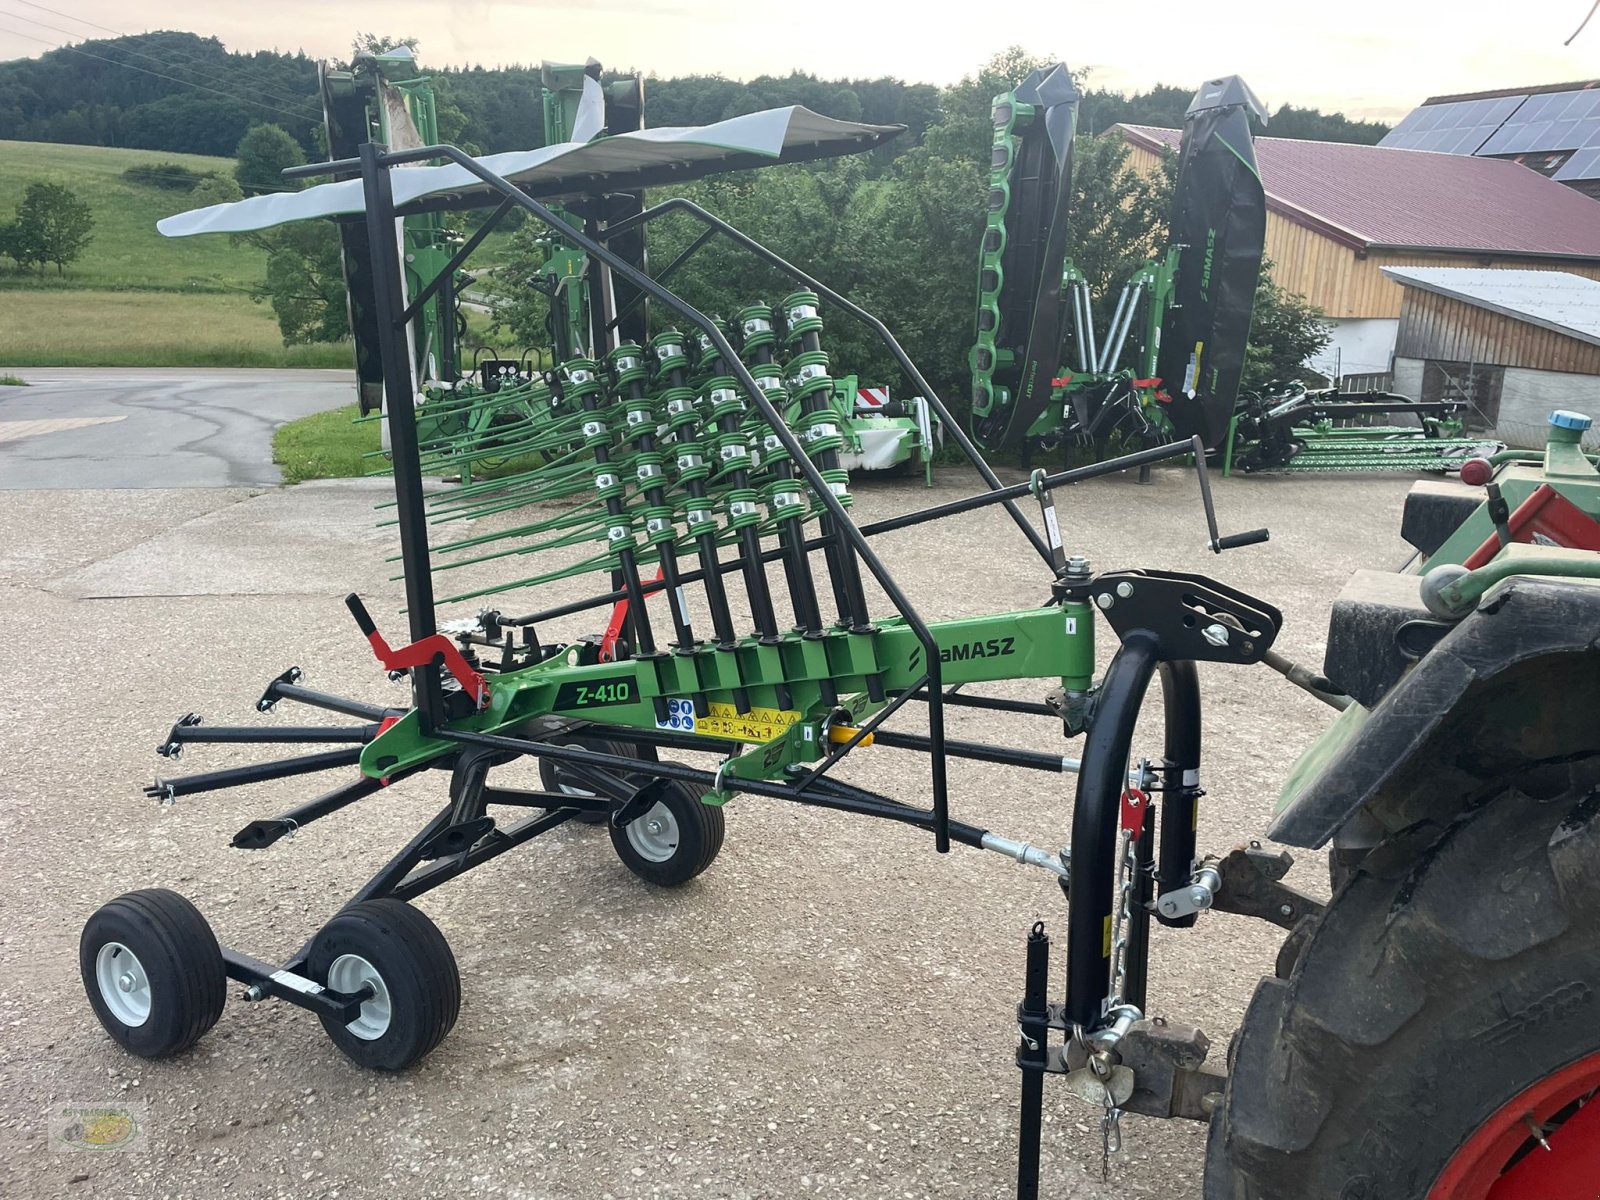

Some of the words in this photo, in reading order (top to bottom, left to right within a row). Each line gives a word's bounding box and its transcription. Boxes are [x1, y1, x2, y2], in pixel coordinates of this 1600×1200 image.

[1202, 228, 1216, 288] SaMASZ
[939, 637, 1015, 663] aMASZ
[576, 683, 628, 704] Z-410
